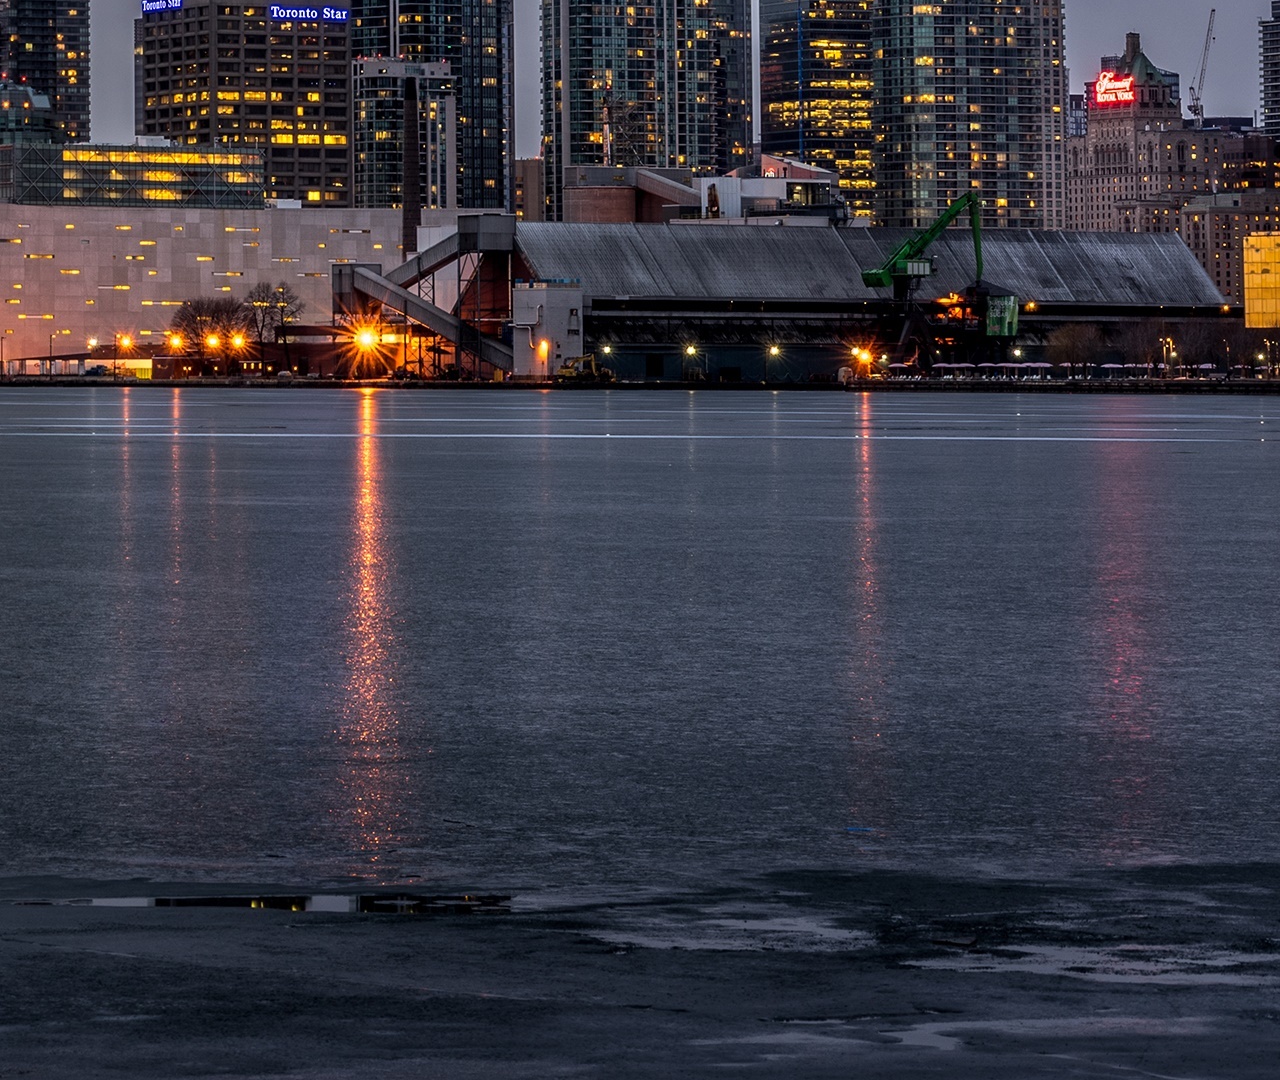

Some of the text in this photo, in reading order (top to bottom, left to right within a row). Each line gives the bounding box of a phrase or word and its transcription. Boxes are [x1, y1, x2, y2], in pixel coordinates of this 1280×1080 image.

[142, 0, 167, 11] Toronto
[270, 6, 347, 19] Toronto Star
[1097, 91, 1134, 102] ROYAL YORK
